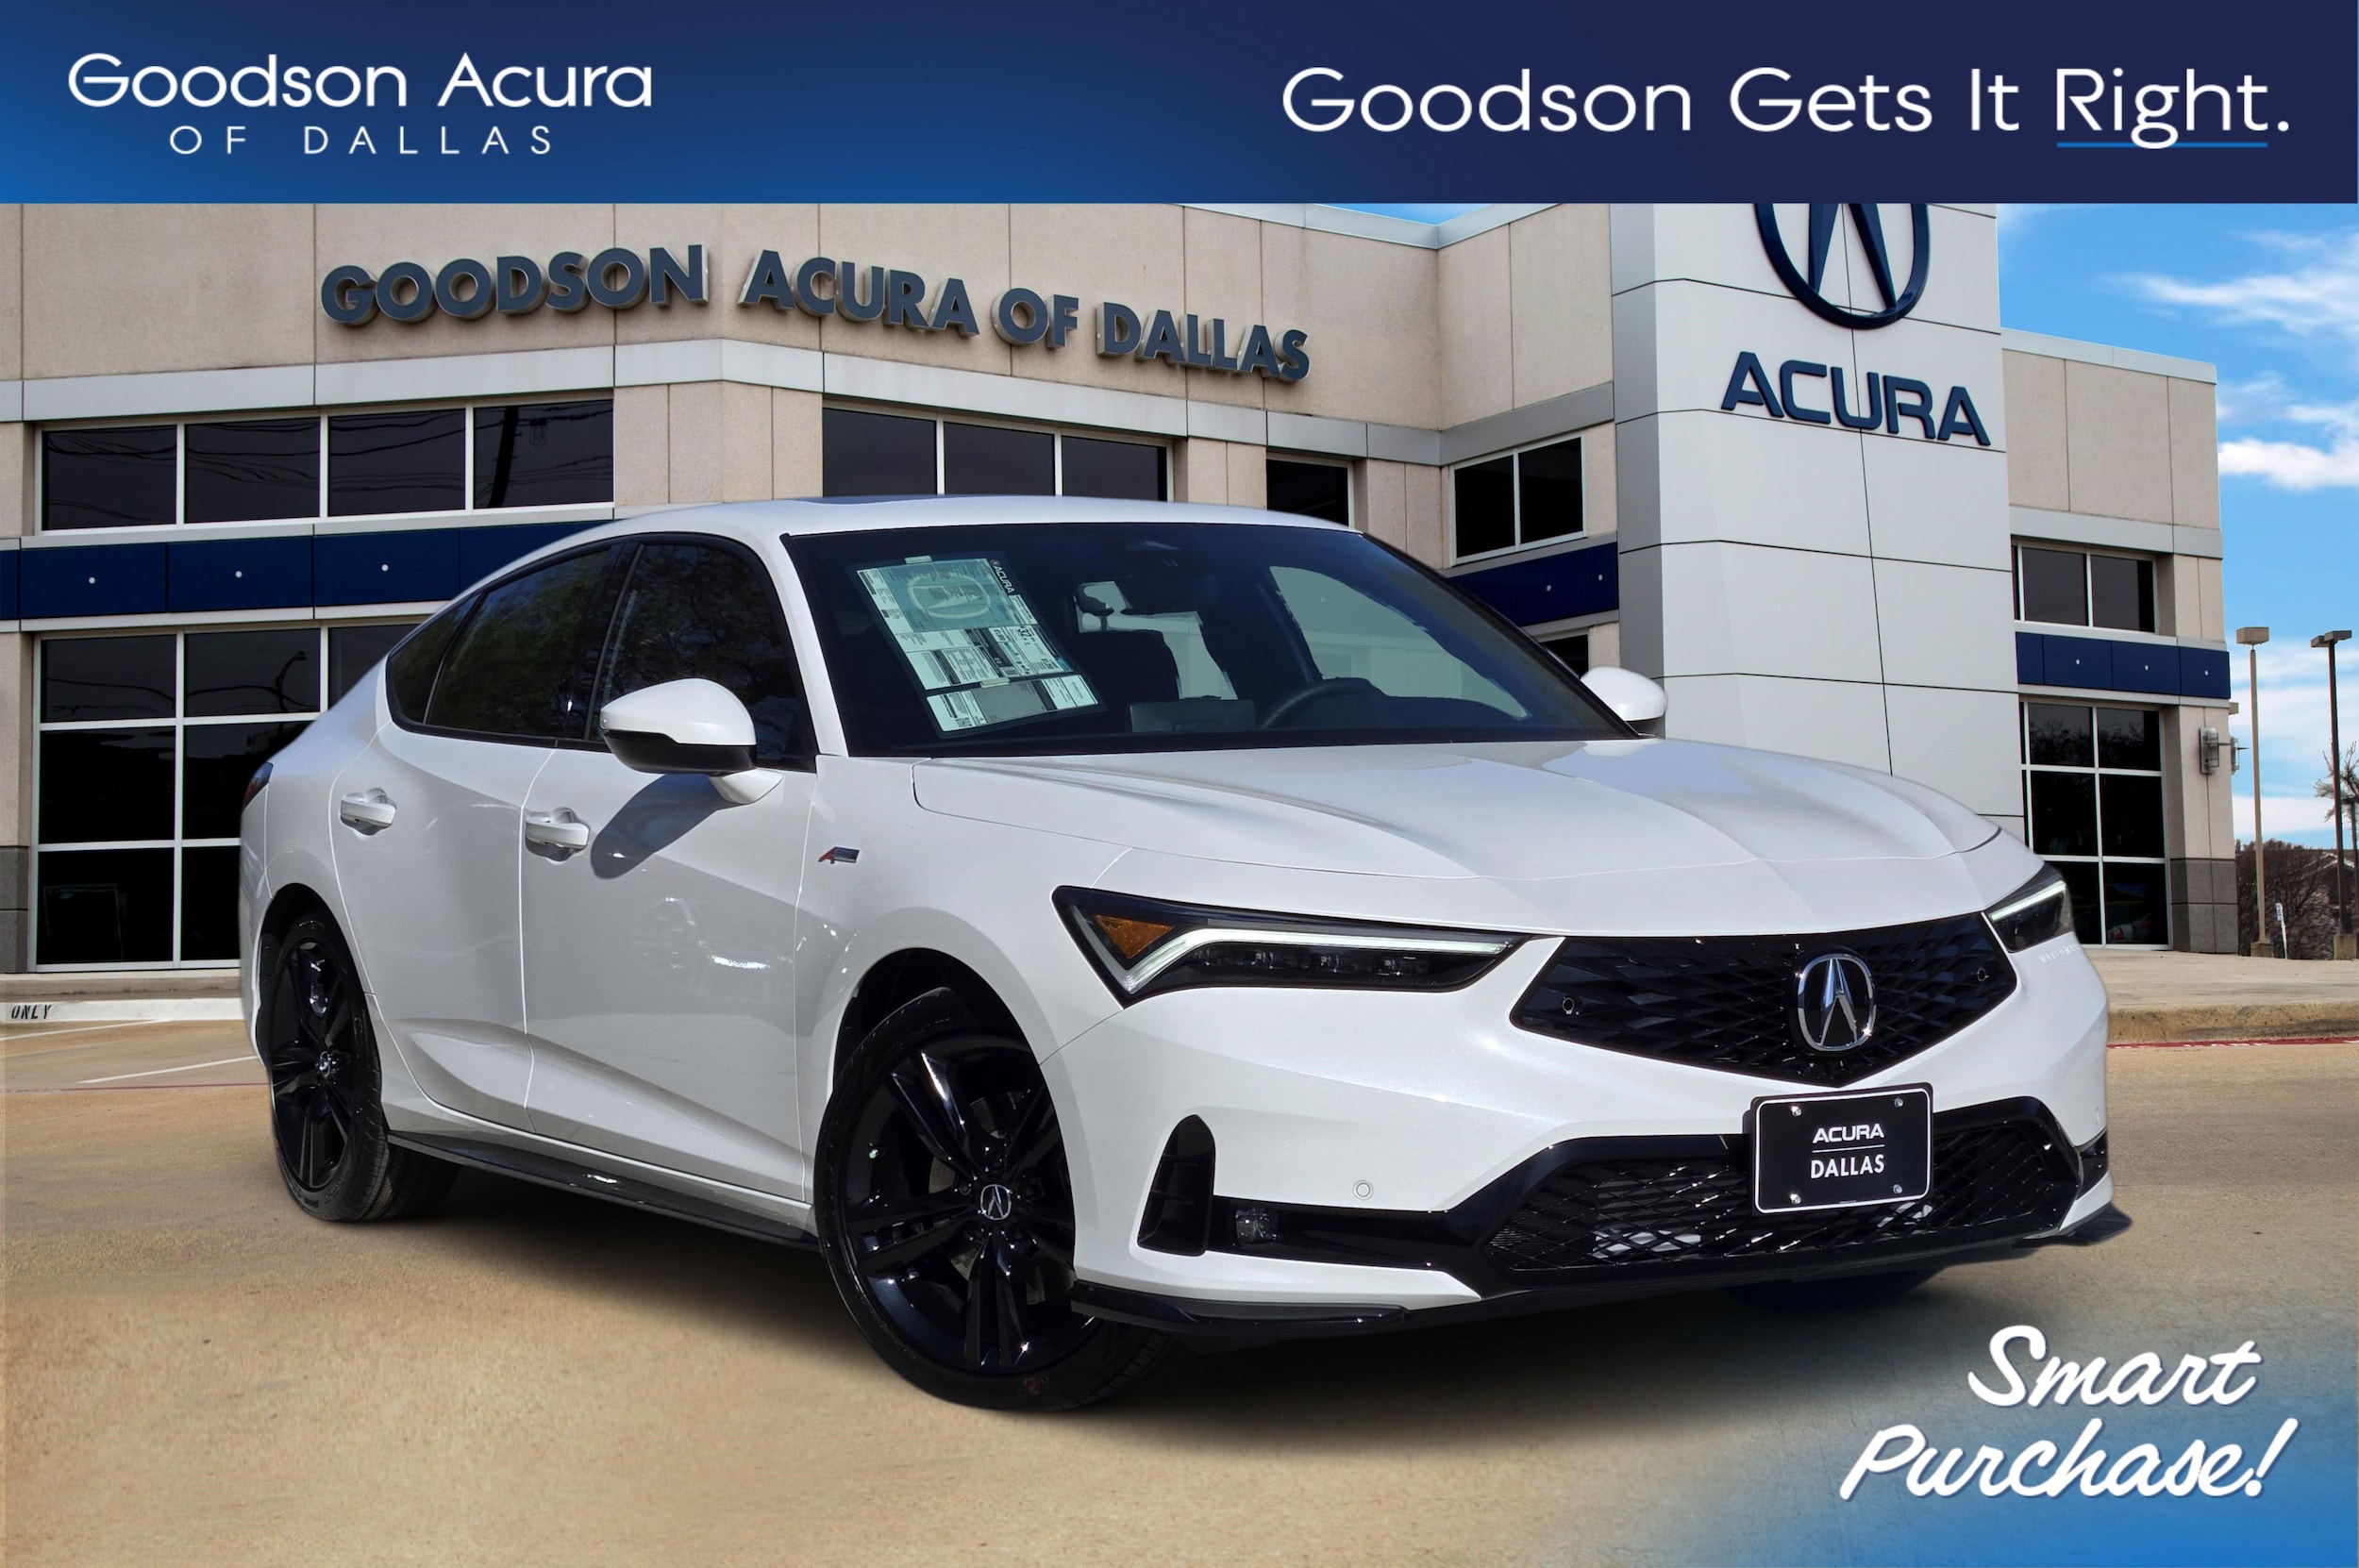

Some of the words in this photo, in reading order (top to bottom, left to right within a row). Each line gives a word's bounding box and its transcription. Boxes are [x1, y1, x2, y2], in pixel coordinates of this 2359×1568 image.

[321, 244, 709, 326] GOODSON
[739, 249, 980, 337] ACURA
[992, 288, 1079, 349] OF
[1096, 302, 1310, 382] DALLAS
[1721, 350, 1992, 446] ACURA
[993, 566, 1015, 593] ACURA
[11, 1004, 52, 1020] ONLY
[1812, 1123, 1885, 1144] ACURA
[1811, 1153, 1885, 1179] DALLAS
